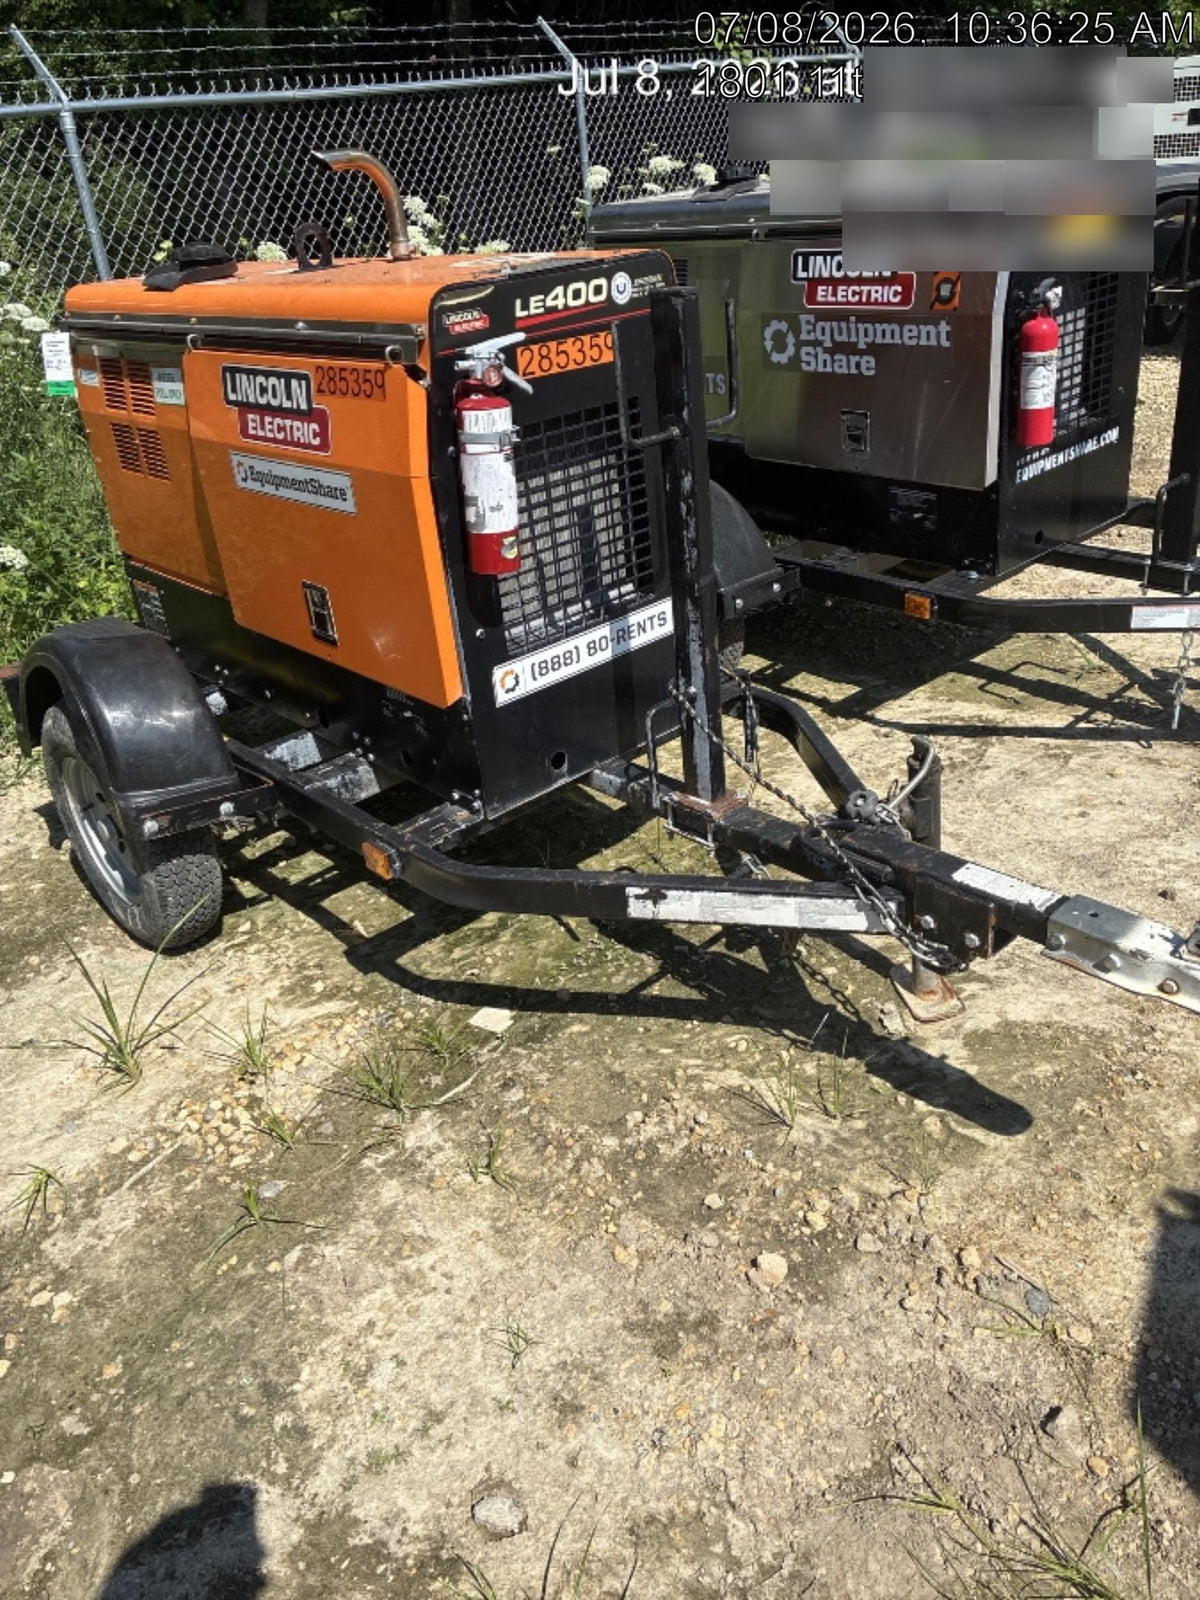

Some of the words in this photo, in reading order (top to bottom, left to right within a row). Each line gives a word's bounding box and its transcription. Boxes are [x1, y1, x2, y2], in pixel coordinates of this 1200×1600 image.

[796, 255, 892, 278] LINC
[514, 276, 608, 318] LE400
[816, 285, 903, 303] ELECTRIC
[798, 314, 953, 349] Equipment
[800, 346, 876, 377] Share
[225, 372, 308, 411] LINCOLN
[315, 365, 386, 399] 285359
[246, 413, 321, 446] ELECTRIC
[248, 465, 348, 502] EquipmentShare
[530, 645, 581, 681] (888)
[586, 611, 668, 657] 80-RENTS
